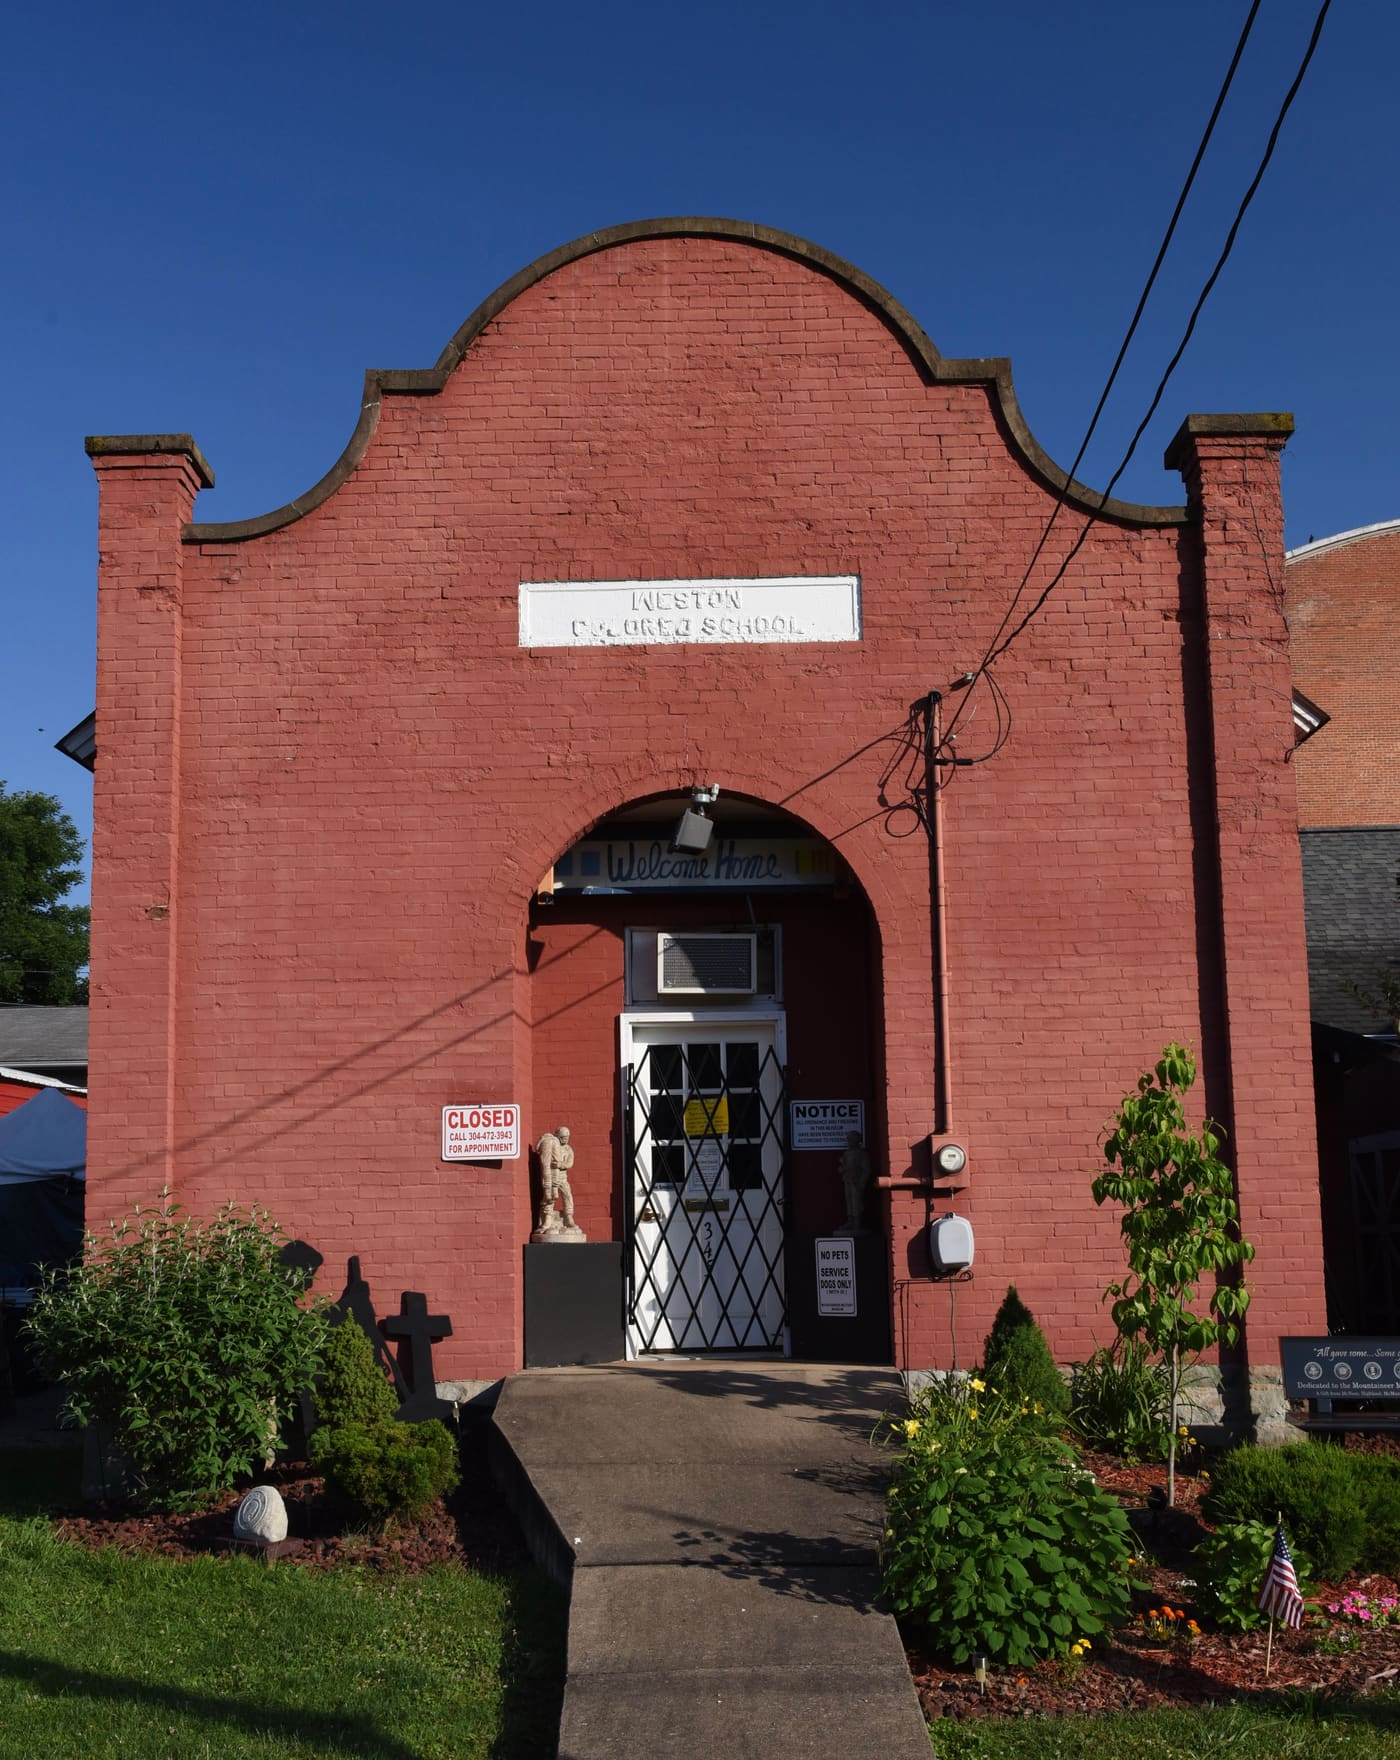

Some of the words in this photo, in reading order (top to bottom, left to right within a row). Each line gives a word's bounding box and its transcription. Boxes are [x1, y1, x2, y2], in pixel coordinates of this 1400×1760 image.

[632, 588, 742, 611] WESTON
[572, 616, 691, 638] COLORED
[701, 614, 805, 636] SCHOOL
[607, 841, 711, 883] Welcome
[713, 840, 783, 880] Home
[795, 1105, 859, 1118] NOTICE
[448, 1110, 514, 1129] CLOSED
[449, 1132, 467, 1141] CALL
[468, 1130, 513, 1141] 304-472-3943
[448, 1145, 463, 1154] FOR
[464, 1143, 513, 1153] APPOINTMENT
[820, 1251, 830, 1260] NO
[832, 1250, 849, 1260] PETS
[820, 1267, 849, 1277] SERVICE
[820, 1279, 836, 1289] DOGS
[837, 1279, 852, 1289] ONLY
[1330, 1350, 1347, 1361] gave
[1375, 1348, 1396, 1358] Some
